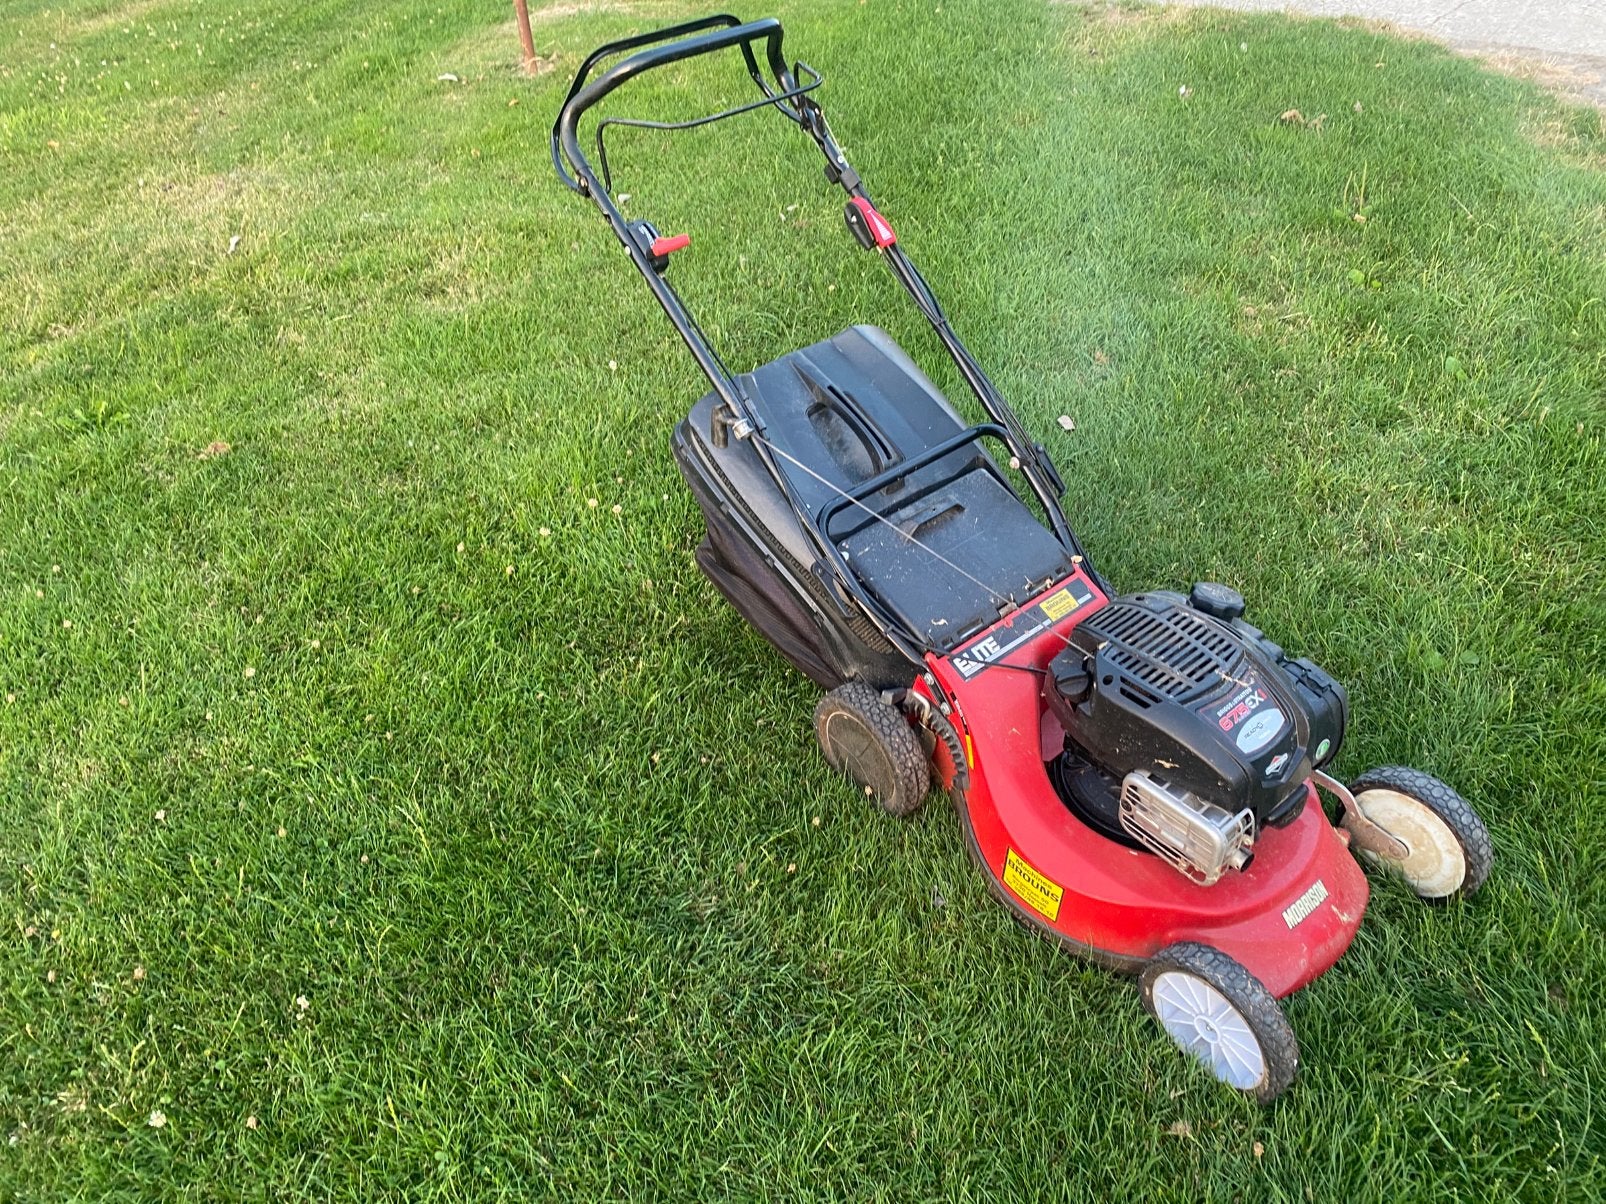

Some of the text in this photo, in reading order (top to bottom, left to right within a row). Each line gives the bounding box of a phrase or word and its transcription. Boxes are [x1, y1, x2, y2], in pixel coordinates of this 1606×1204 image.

[953, 636, 1000, 673] ELITE
[1008, 858, 1060, 902] BROUNS
[1015, 858, 1053, 890] Machines
[1281, 879, 1329, 930] MORRISON
